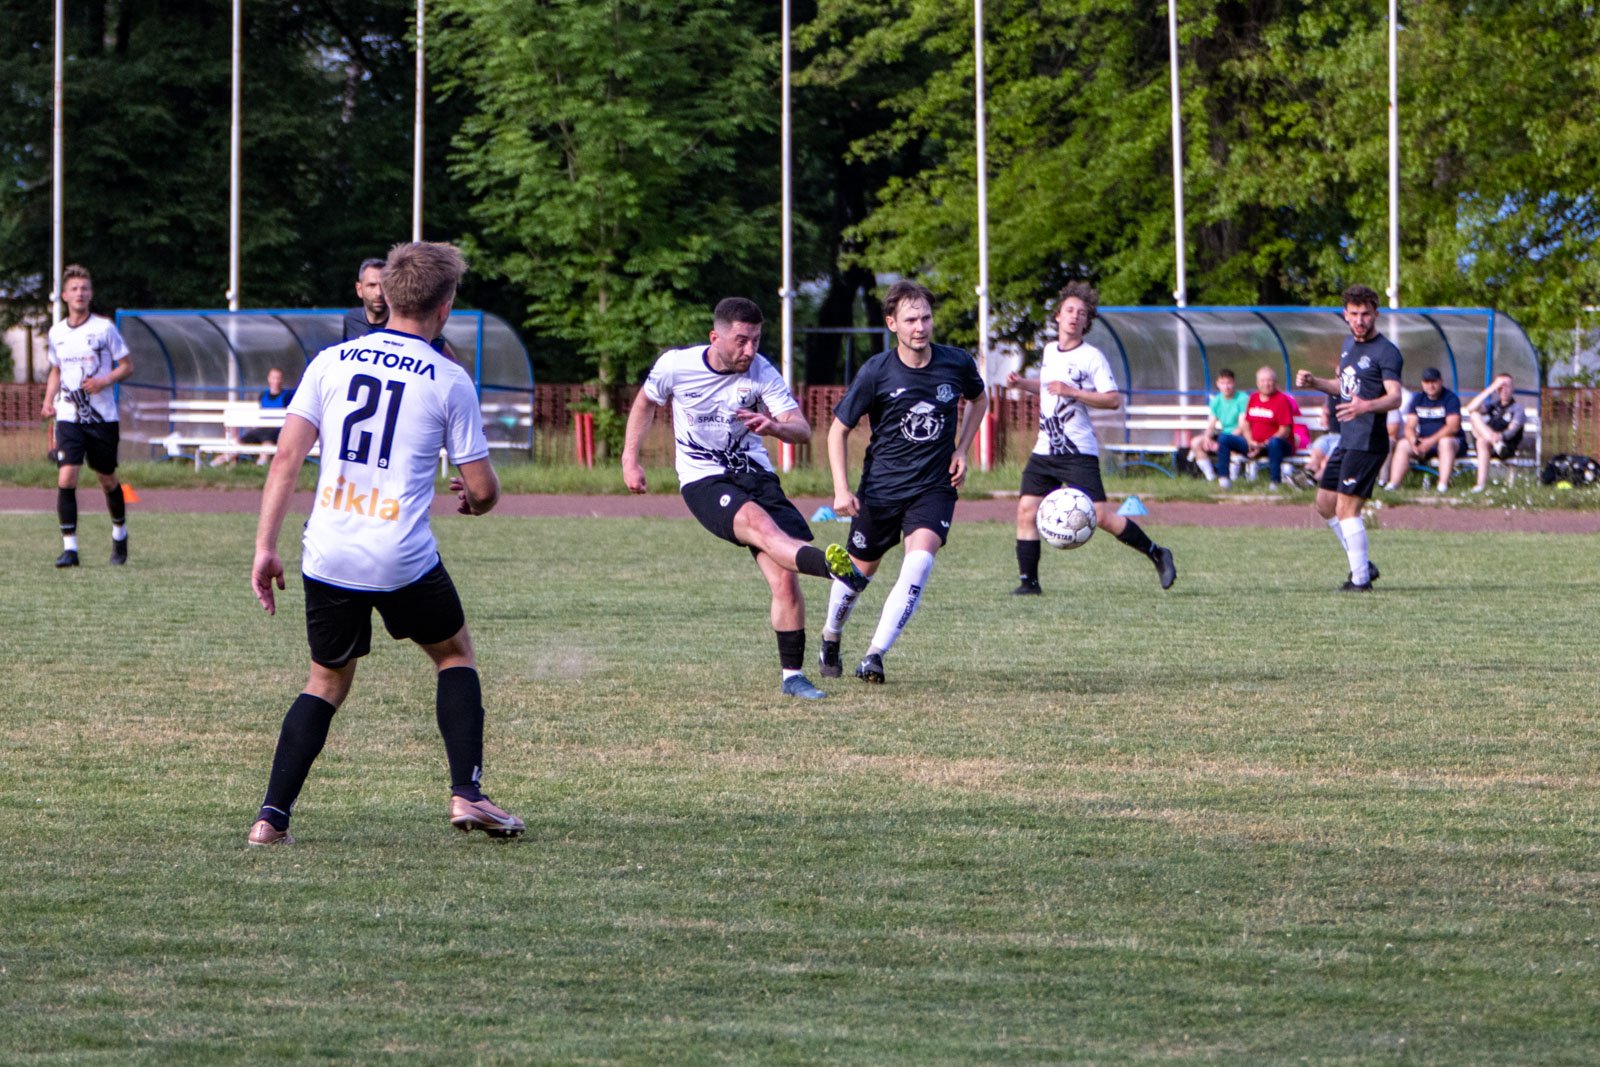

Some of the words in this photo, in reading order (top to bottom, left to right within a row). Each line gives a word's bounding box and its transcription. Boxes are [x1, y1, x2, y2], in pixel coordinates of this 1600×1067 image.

[339, 348, 436, 381] VICTORIA
[338, 373, 406, 469] 21
[320, 474, 400, 522] sikla
